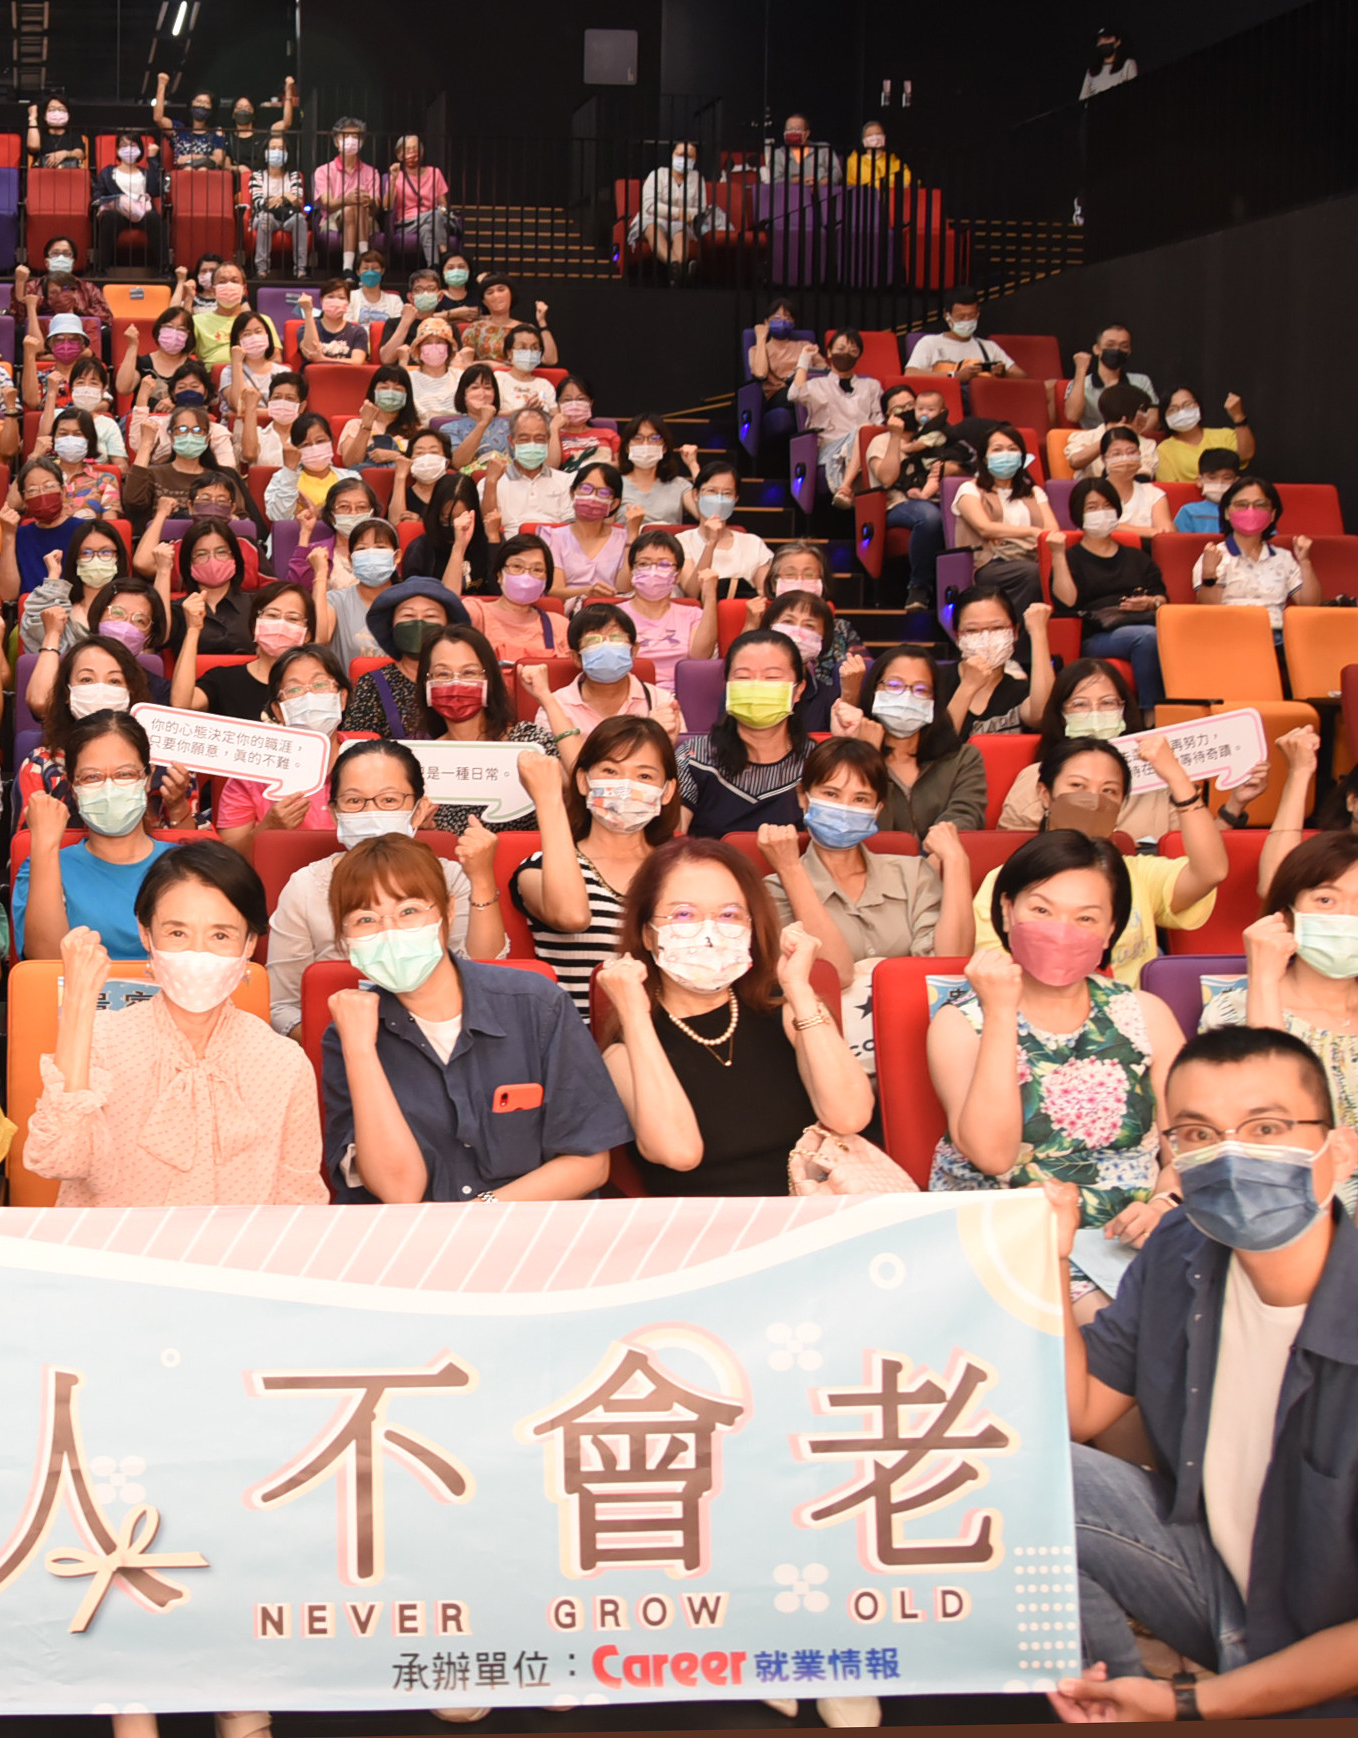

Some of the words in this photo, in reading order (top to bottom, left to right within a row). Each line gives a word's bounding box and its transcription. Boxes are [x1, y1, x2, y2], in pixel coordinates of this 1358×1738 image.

[420, 766, 510, 781] 是一種日常。
[257, 1601, 465, 1637] NEVER
[553, 1594, 722, 1631] GROW
[853, 1589, 965, 1622] OLD
[392, 1650, 576, 1692] 承辦單位：
[592, 1644, 747, 1690] Career
[754, 1647, 901, 1682] 就業情報
